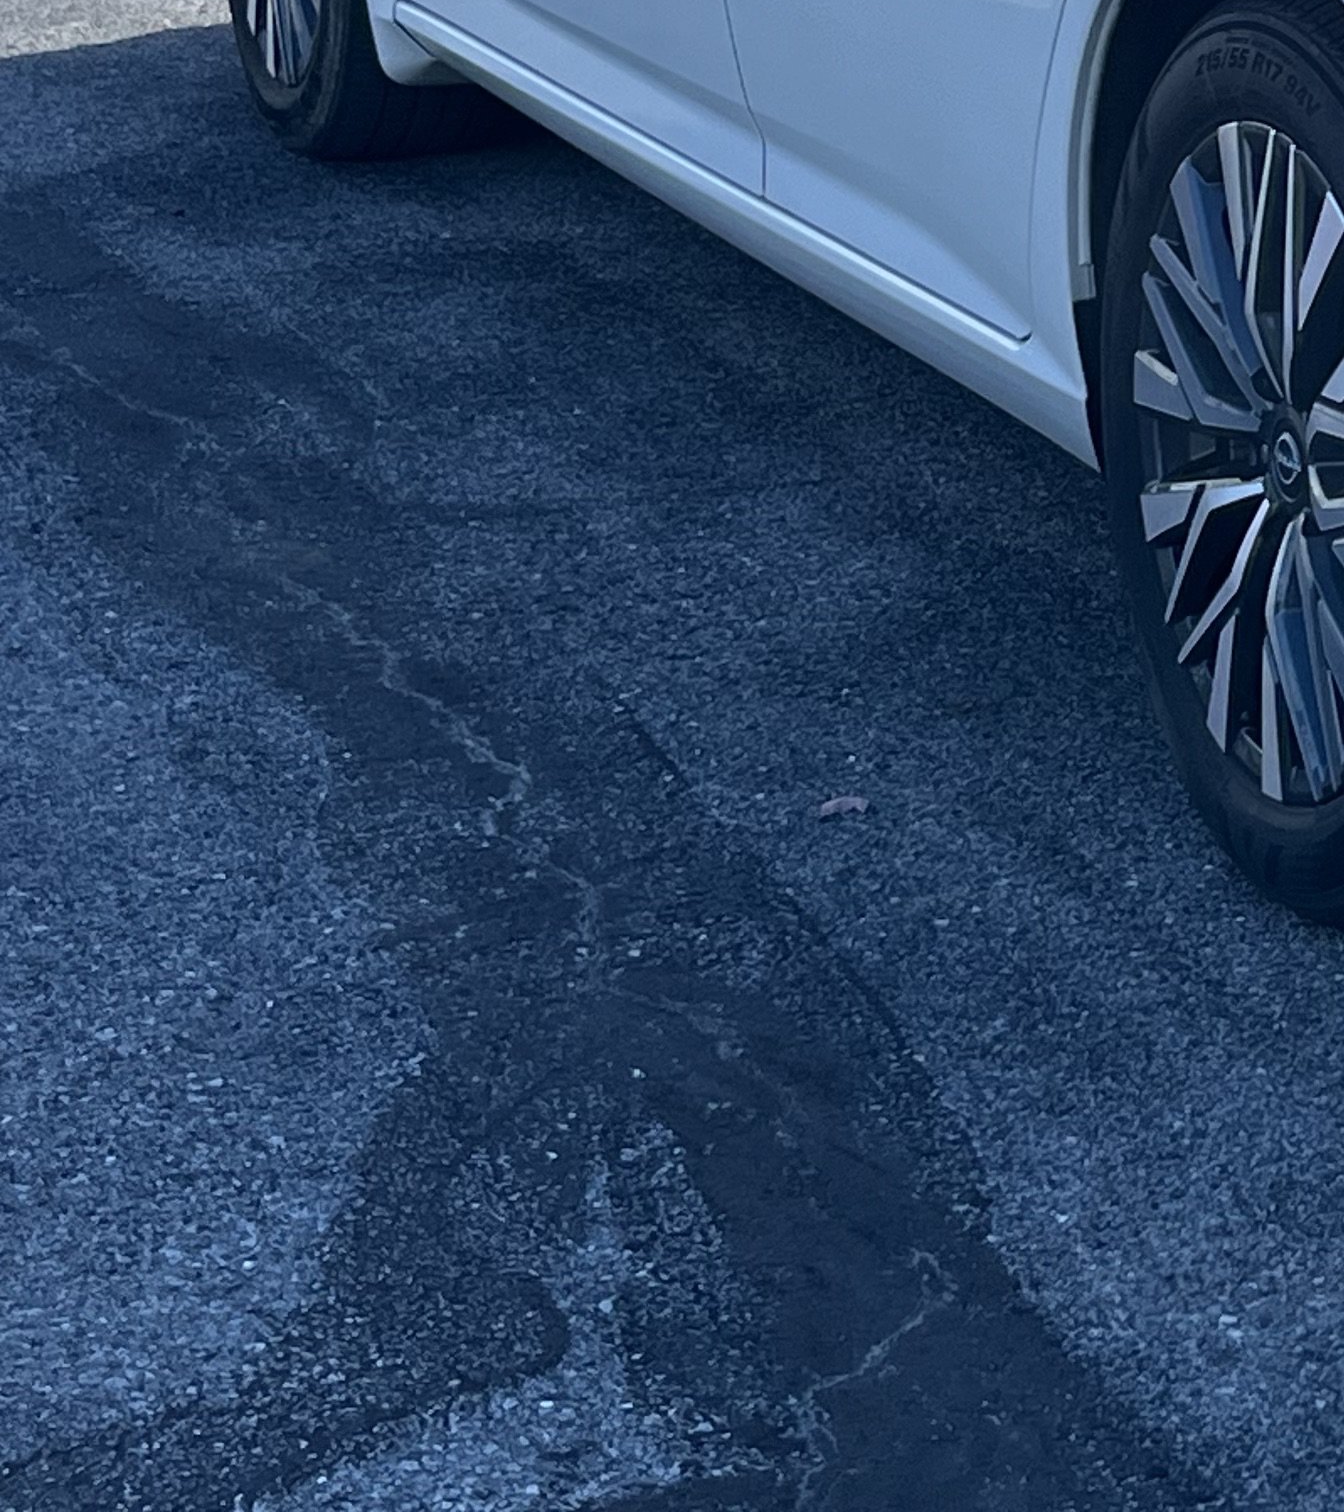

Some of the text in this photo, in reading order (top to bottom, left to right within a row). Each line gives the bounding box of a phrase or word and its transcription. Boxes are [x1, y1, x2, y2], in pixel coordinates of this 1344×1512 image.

[1195, 48, 1322, 117] 215/55 R17 94V
